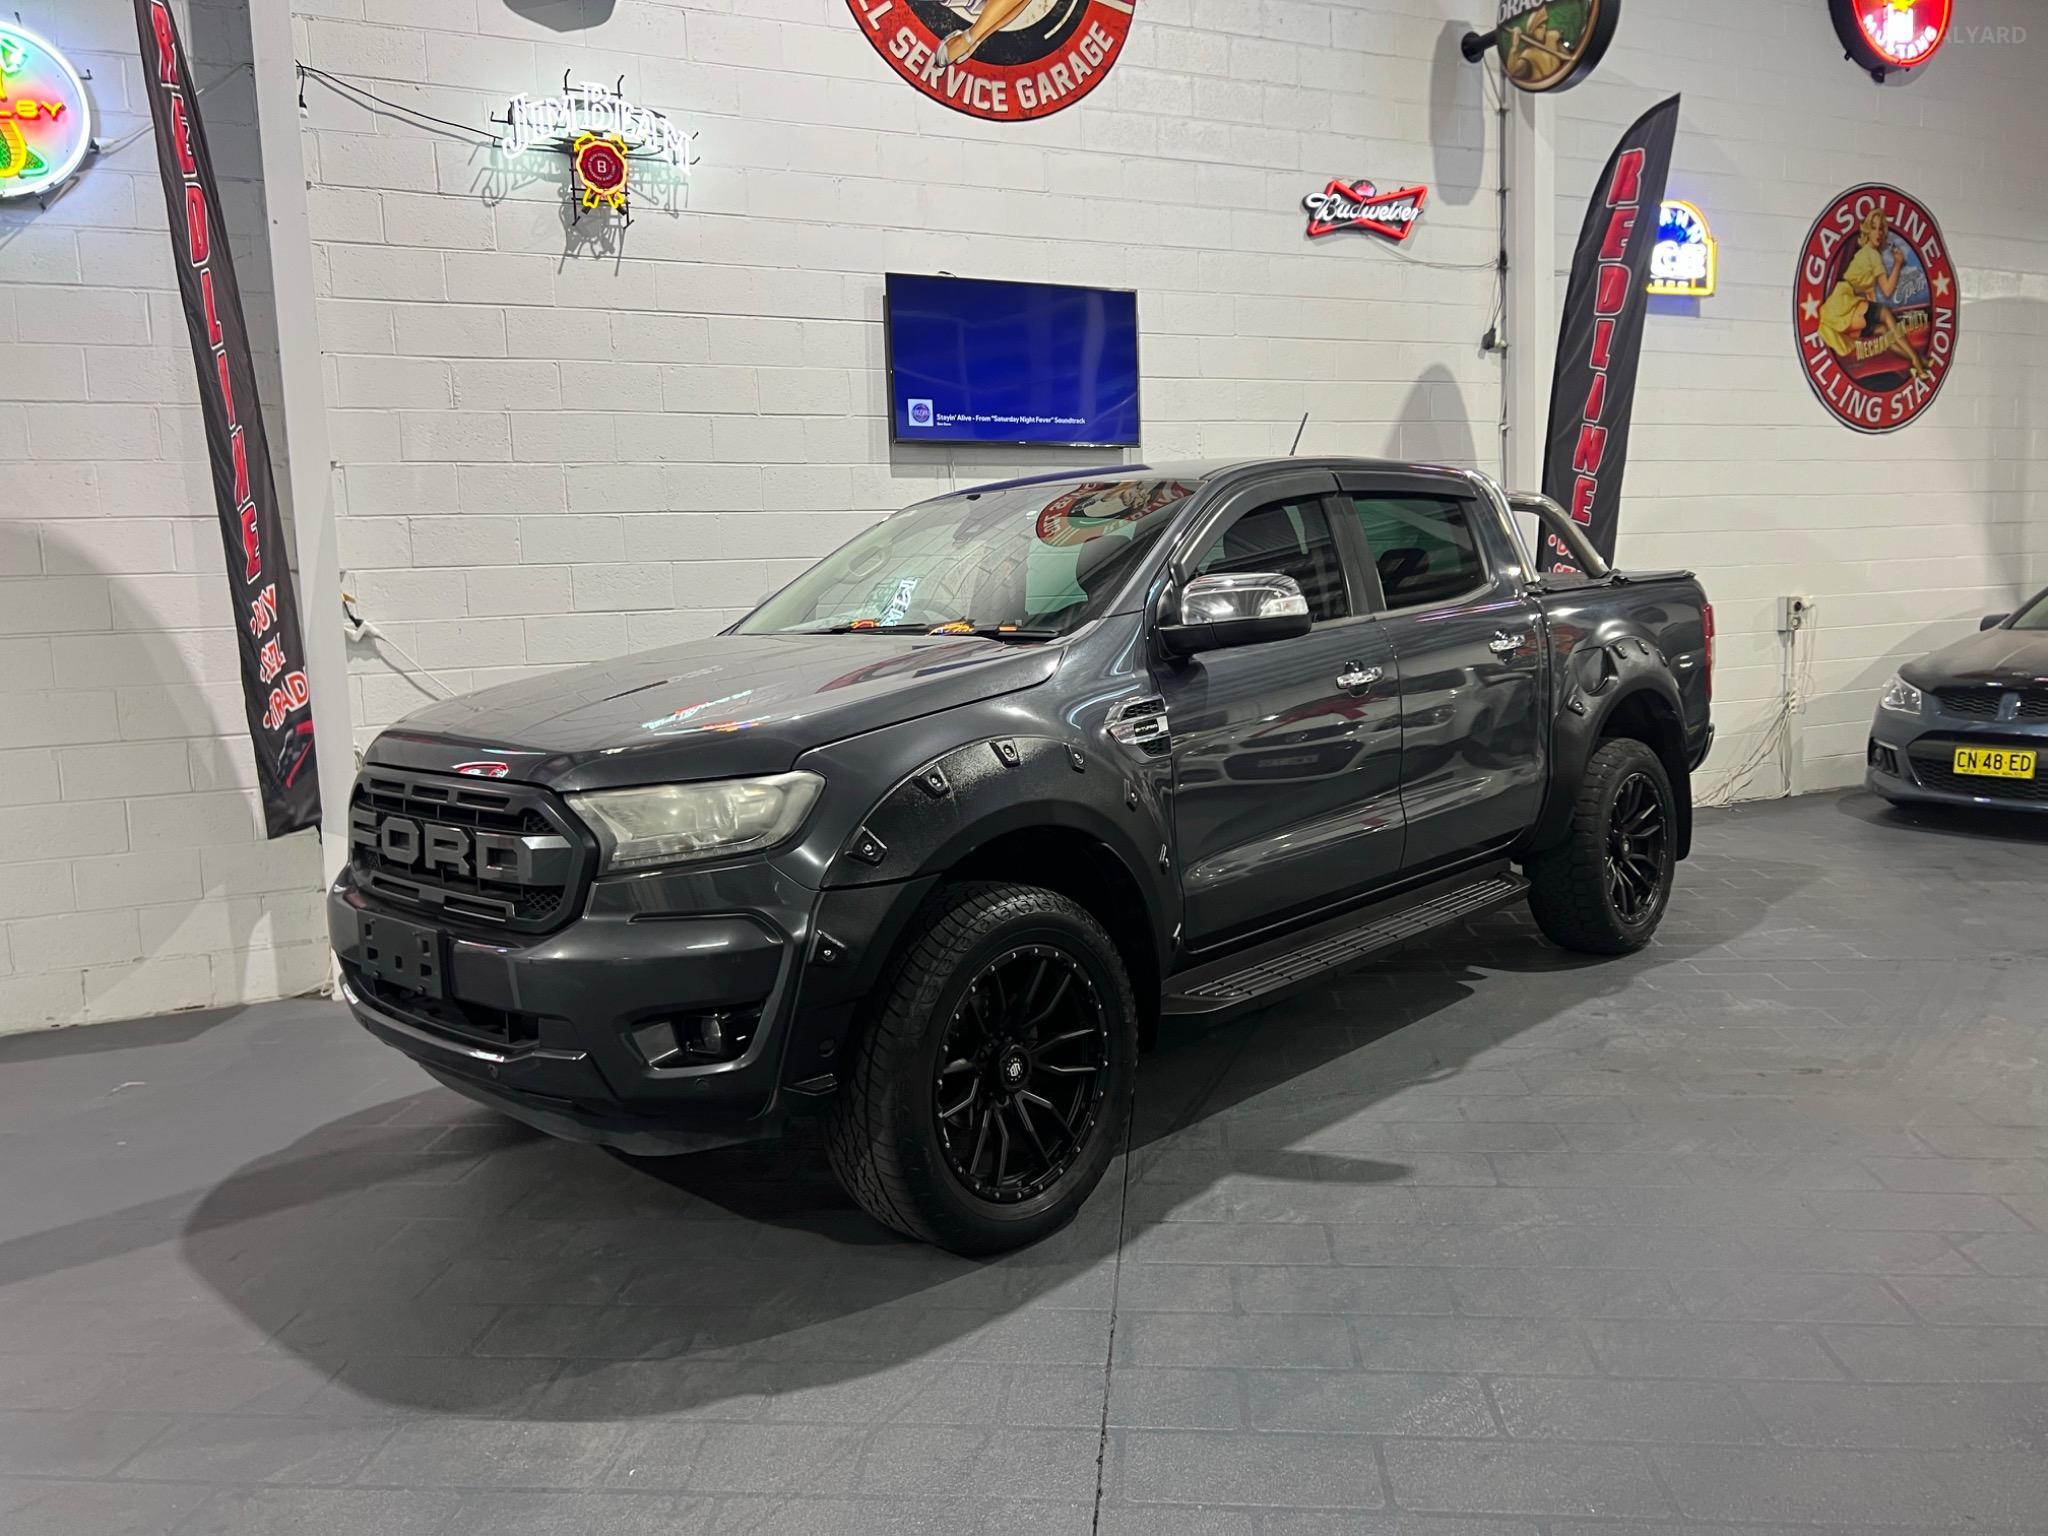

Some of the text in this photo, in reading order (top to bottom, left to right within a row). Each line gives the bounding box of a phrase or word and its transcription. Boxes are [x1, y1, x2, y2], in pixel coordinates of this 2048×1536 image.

[889, 26, 1009, 112] SERVICE
[1015, 21, 1114, 110] GARAGE
[1863, 13, 1937, 59] MUSTANG
[502, 80, 691, 176] JIM BEAM
[1306, 192, 1420, 222] Budweiser
[1804, 195, 1941, 286] GASOLINE
[149, 0, 262, 584] REDLINE
[1570, 147, 1645, 527] REDLINE
[937, 413, 957, 423] Stayin'
[957, 413, 971, 422] Alive
[976, 414, 991, 422] From
[1020, 415, 1035, 424] Night
[1055, 416, 1086, 425] Soundtrack
[1804, 331, 1882, 423] FILLING
[1956, 751, 1978, 769] CN
[1983, 753, 2003, 771] 48
[2009, 754, 2032, 773] ED
[350, 803, 533, 884] FORD
